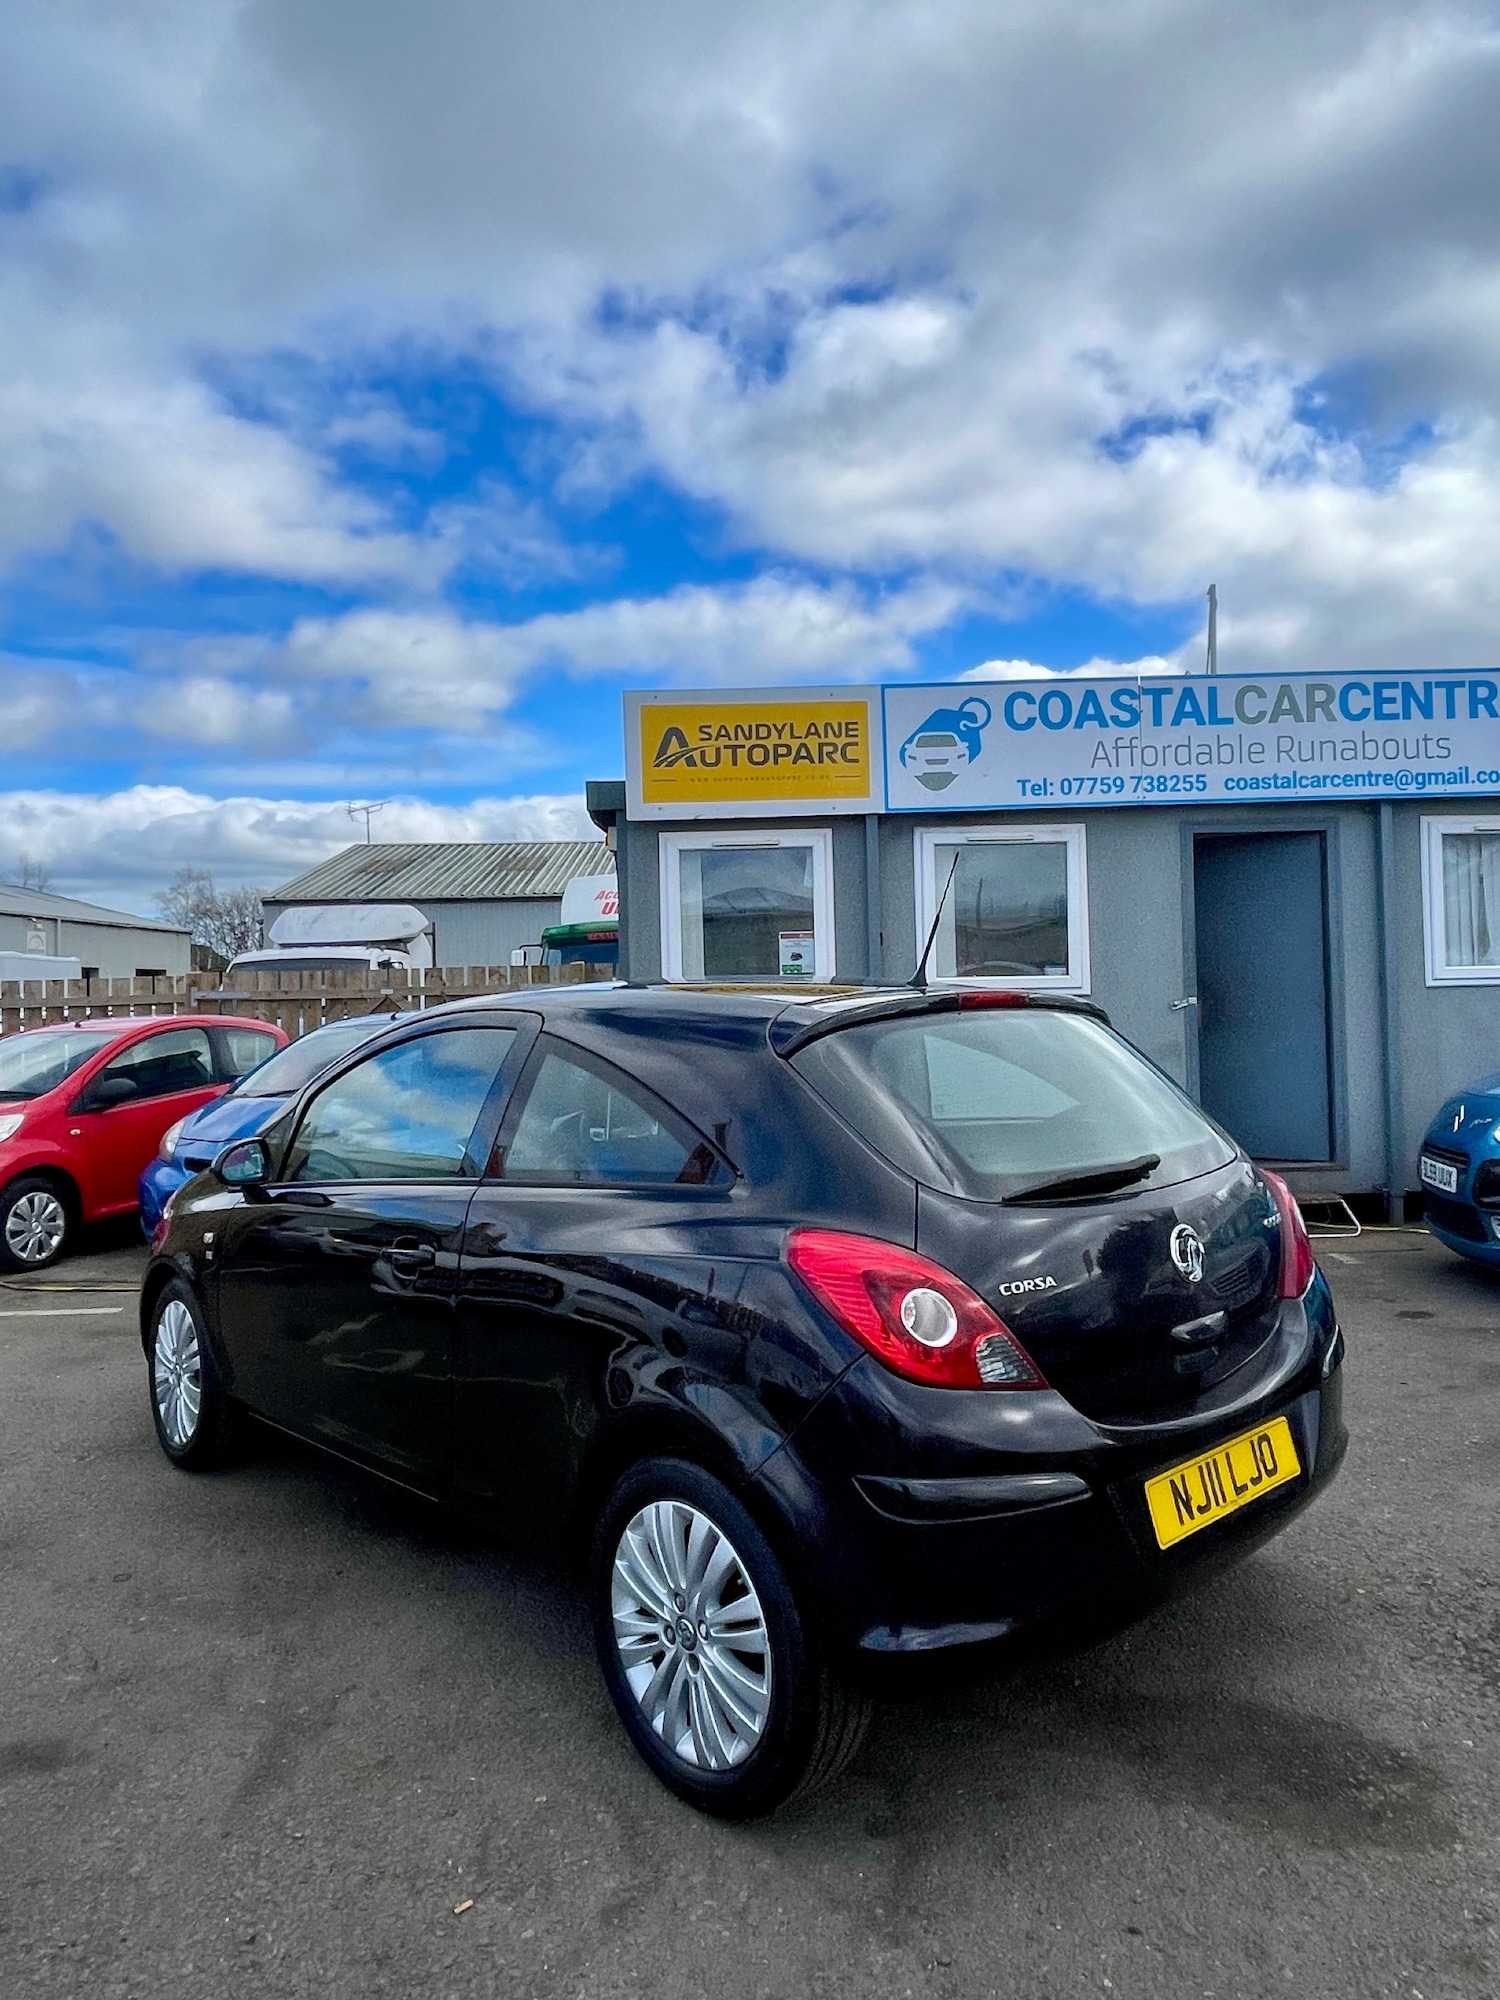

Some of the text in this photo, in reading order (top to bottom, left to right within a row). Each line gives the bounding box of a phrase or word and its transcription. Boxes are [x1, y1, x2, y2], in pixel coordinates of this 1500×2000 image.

[699, 721, 859, 742] SANDYLANE
[653, 727, 860, 768] AUTOPARC
[1090, 730, 1451, 768] Affordable Runabouts
[1017, 777, 1054, 796] Tel:
[1060, 776, 1125, 795] 07759
[1130, 774, 1207, 793] 738255
[998, 1275, 1058, 1296] CORSA
[1169, 1432, 1278, 1527] NJ11 LJO
